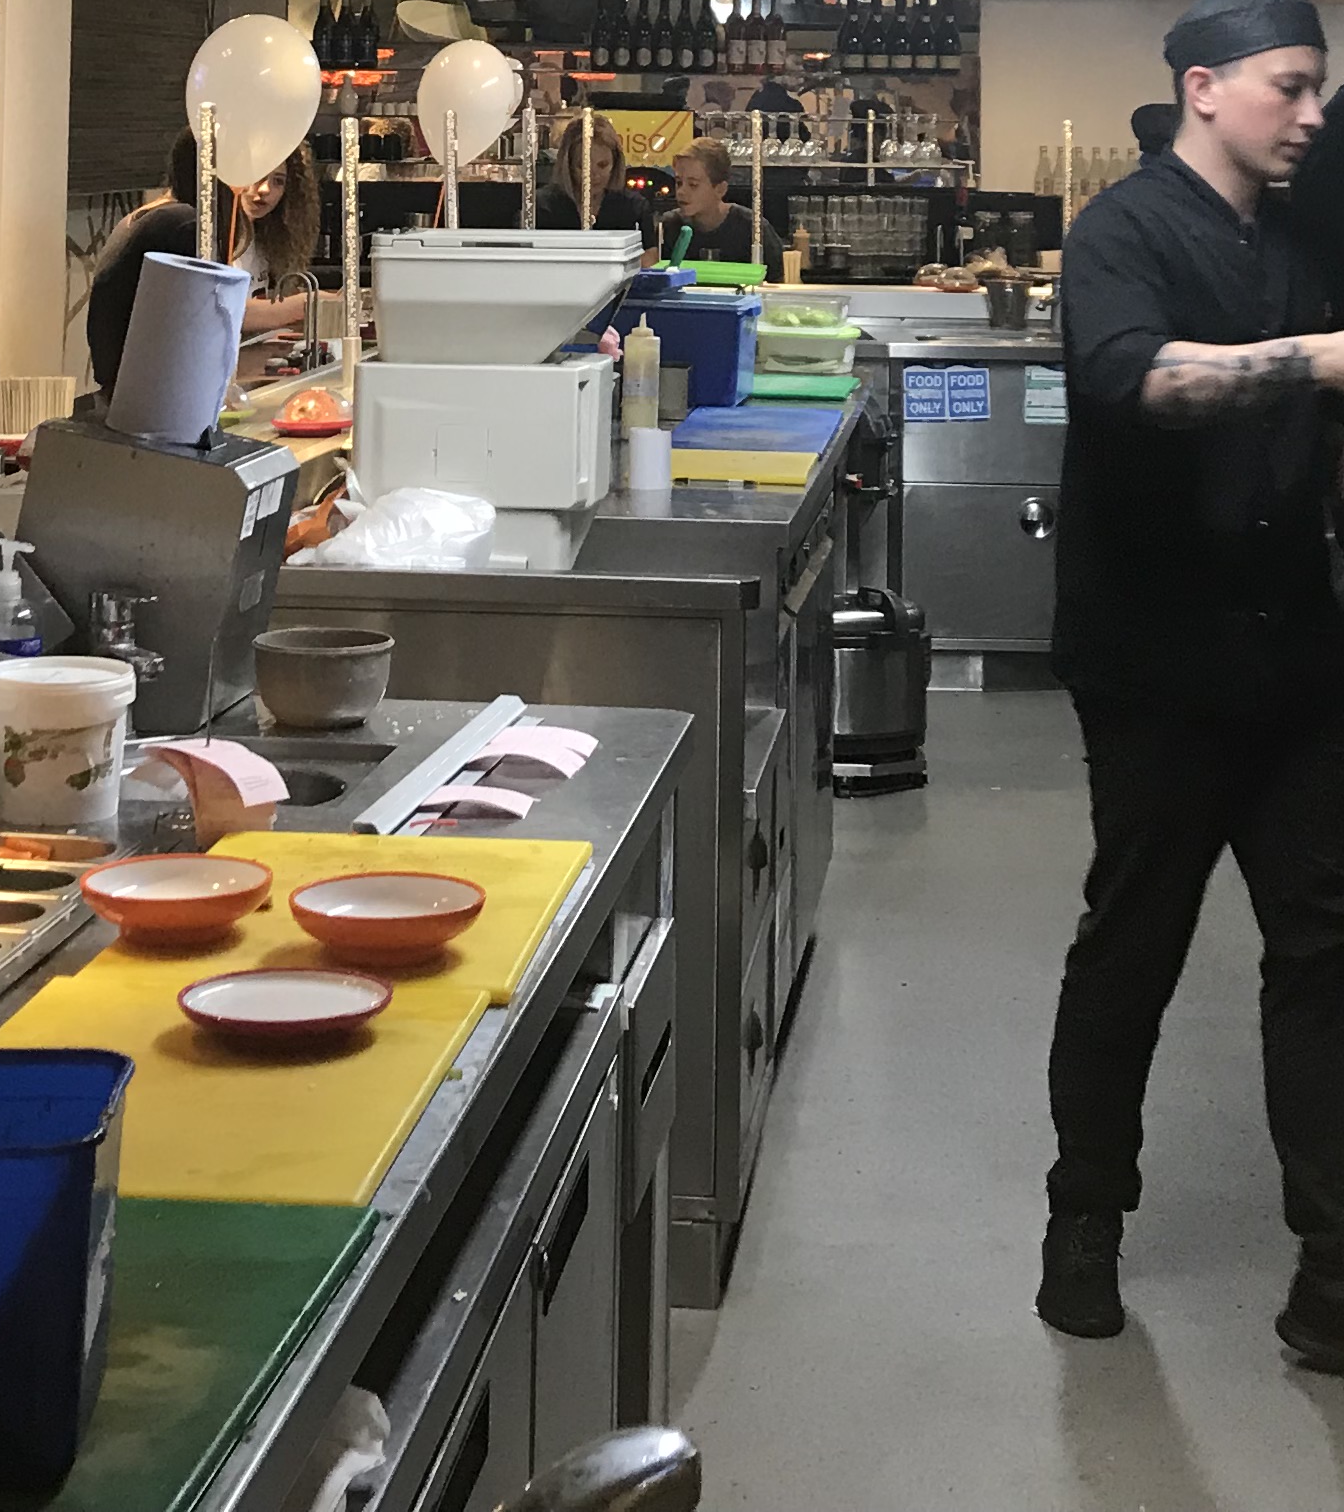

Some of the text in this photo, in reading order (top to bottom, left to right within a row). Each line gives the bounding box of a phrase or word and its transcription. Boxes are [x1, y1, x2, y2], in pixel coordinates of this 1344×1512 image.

[908, 375, 943, 387] FOOD
[950, 374, 985, 387] FOOD
[909, 401, 942, 414] ONLY
[952, 400, 985, 414] ONLY
